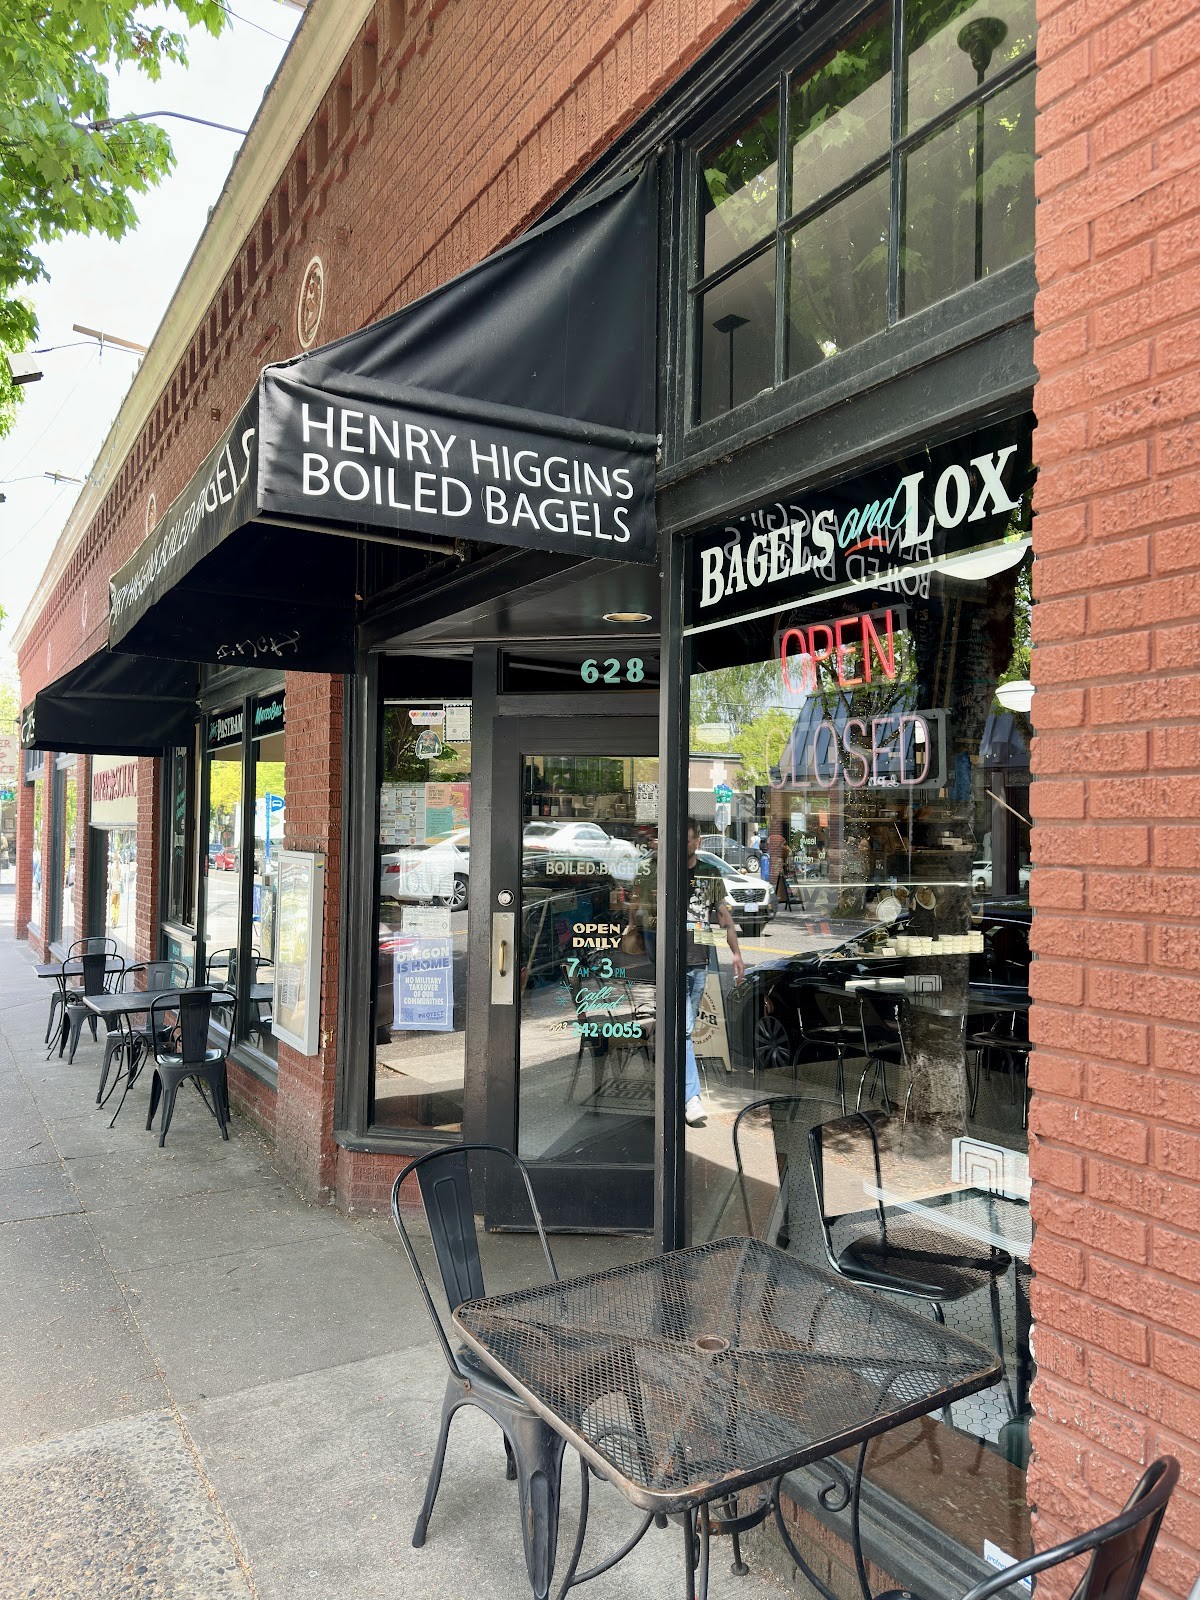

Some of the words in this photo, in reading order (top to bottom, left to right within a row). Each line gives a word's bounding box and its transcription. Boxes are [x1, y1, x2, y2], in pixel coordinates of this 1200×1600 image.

[302, 403, 457, 468] HENRY
[470, 439, 634, 500] HIGGINS
[302, 453, 472, 518] BOILED
[487, 485, 631, 543] BAGELS
[700, 508, 835, 608] BAGELS
[838, 480, 912, 549] and
[899, 444, 1018, 549] LOX
[781, 609, 896, 694] OPEN
[581, 657, 644, 684] 628
[217, 713, 243, 741] PASTRAM
[766, 714, 931, 790] CLOSED
[546, 861, 595, 875] BOILED
[572, 922, 621, 934] OPEN
[572, 937, 622, 948] DAILY
[396, 946, 450, 963] OREGON
[396, 963, 409, 973] IS
[411, 957, 450, 972] HOME
[405, 976, 414, 984] NO
[415, 976, 442, 985] MILITARY
[403, 997, 444, 1005] COMMUNITIES
[575, 986, 613, 1004] Call
